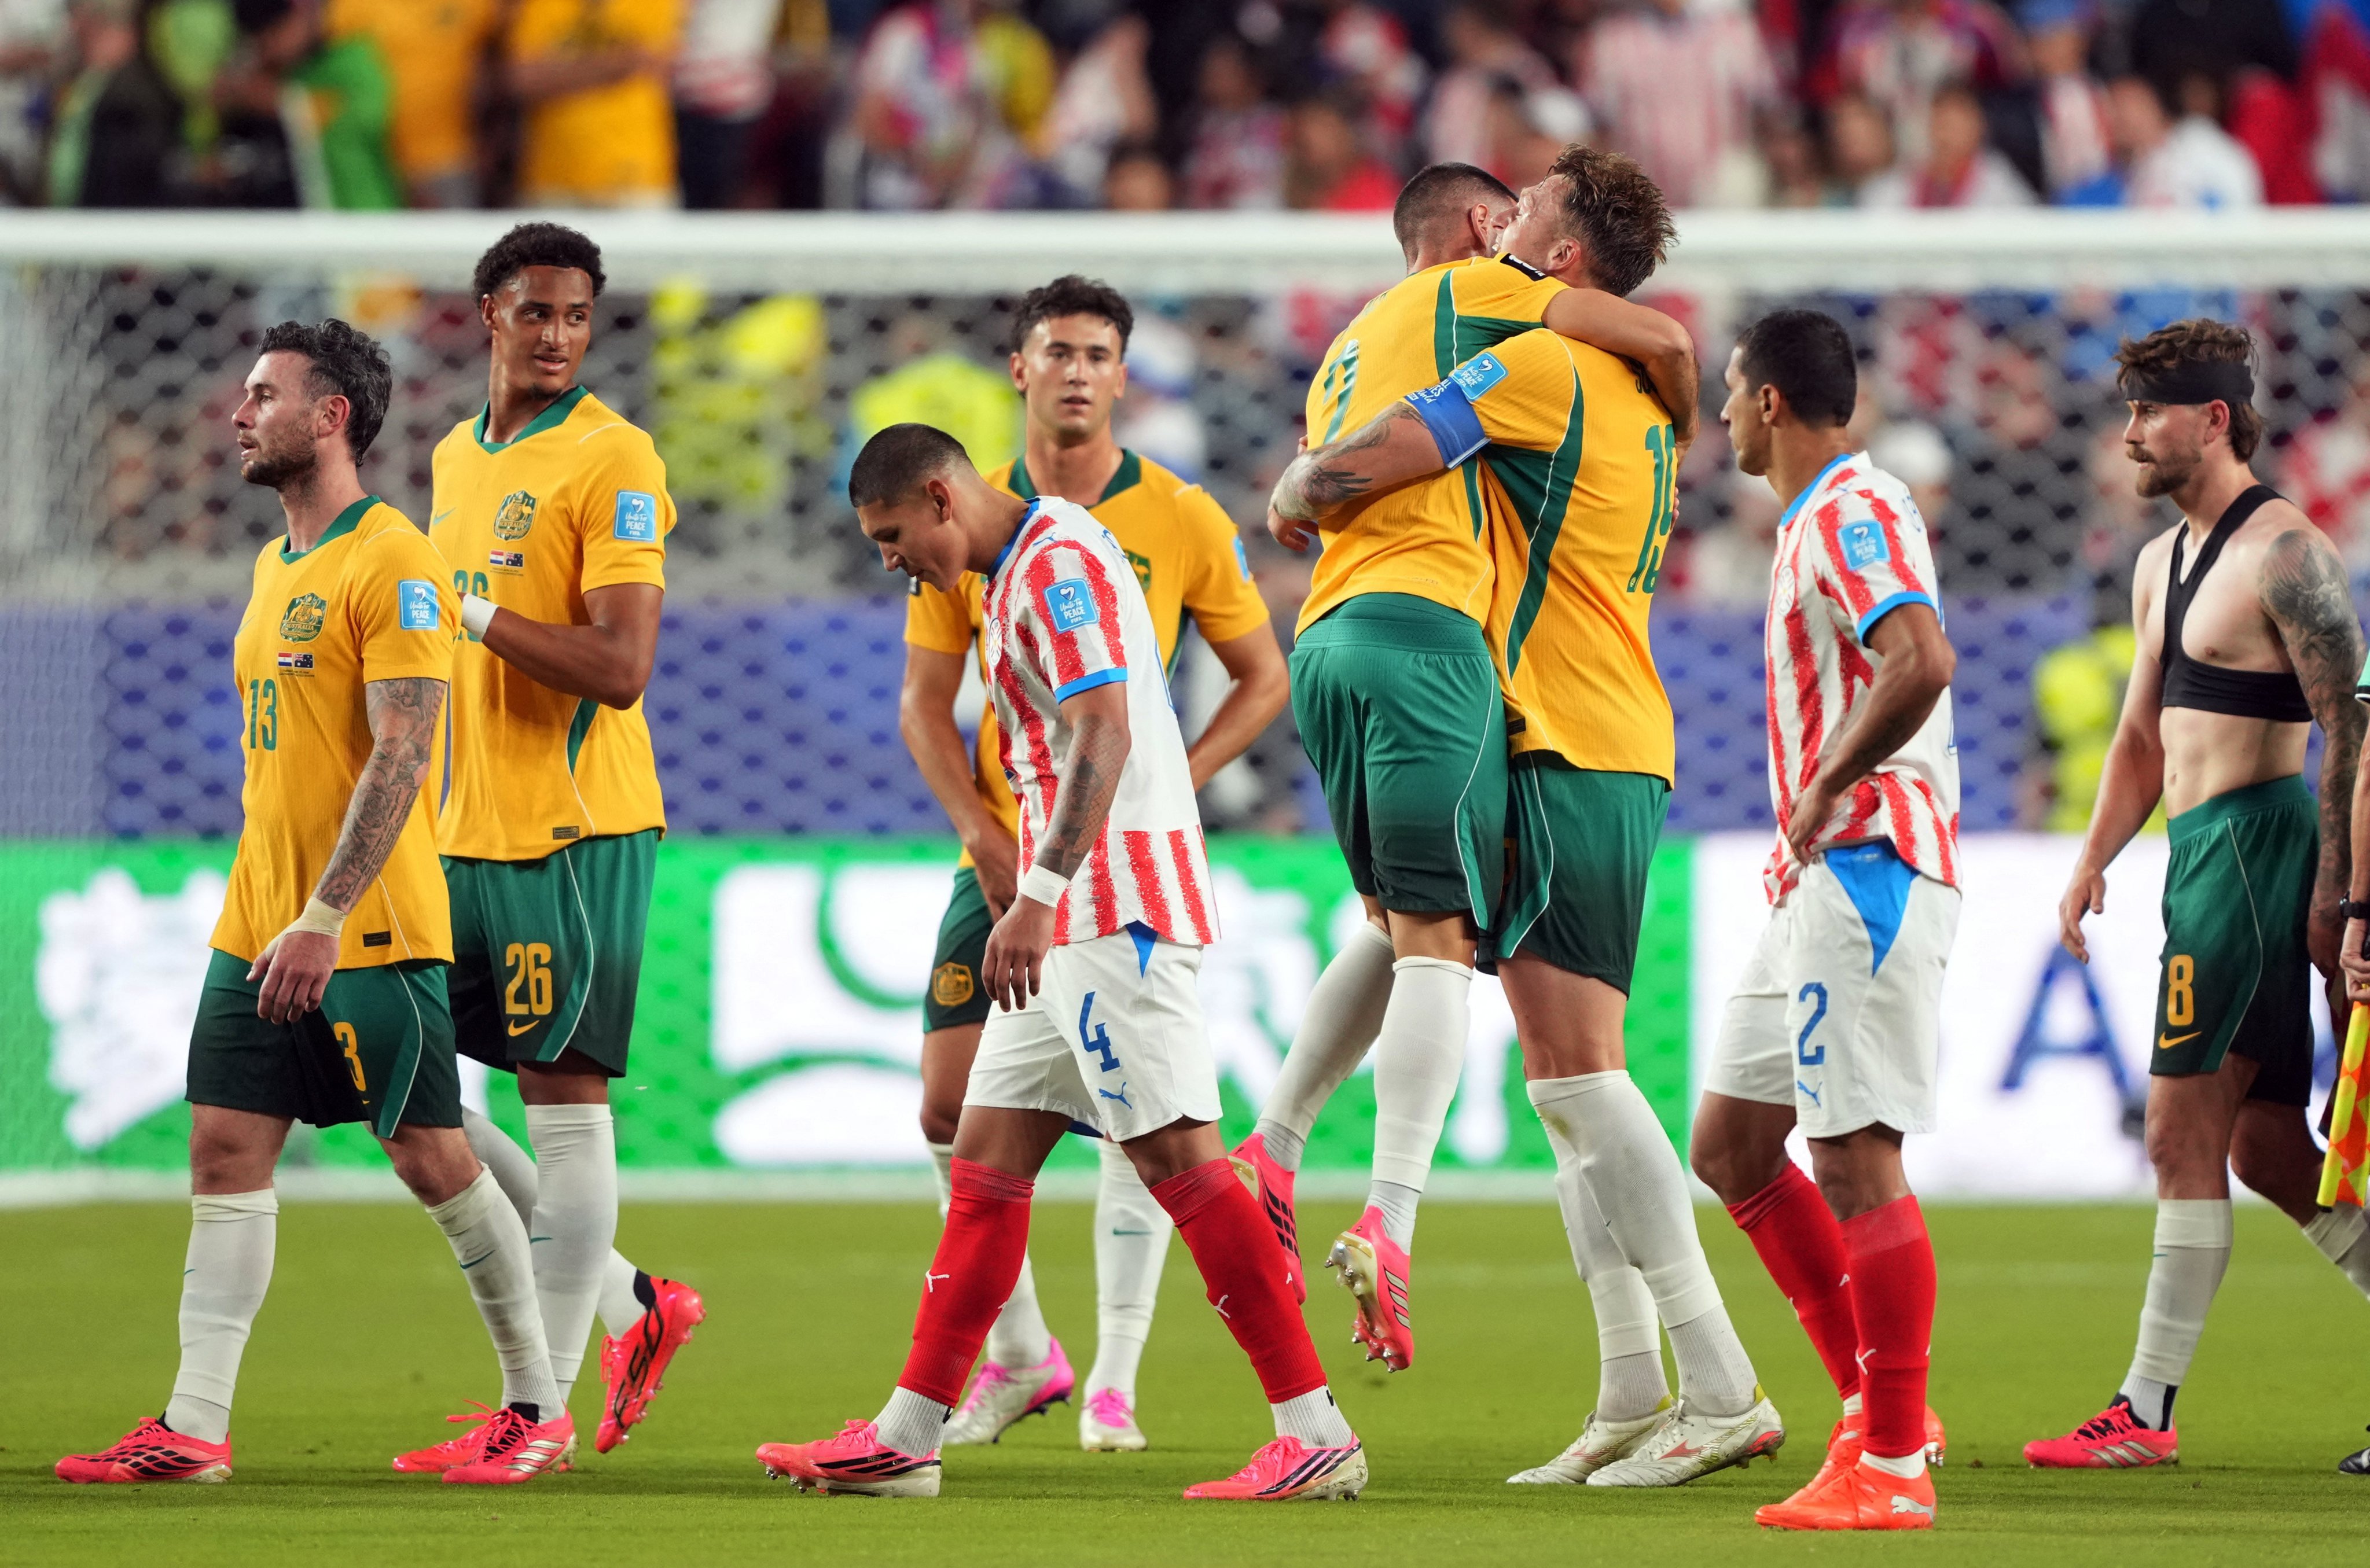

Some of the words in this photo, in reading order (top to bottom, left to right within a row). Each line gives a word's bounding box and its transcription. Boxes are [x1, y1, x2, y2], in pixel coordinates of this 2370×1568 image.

[1461, 370, 1478, 388] PEACE
[626, 521, 646, 531] PEACE
[412, 610, 429, 619] PEACE
[1063, 606, 1086, 620] PEACE
[250, 679, 278, 751] 13
[505, 943, 553, 1015] 26
[2167, 954, 2195, 1026] 8
[1079, 991, 1121, 1073] 4
[1798, 981, 1828, 1066] 2
